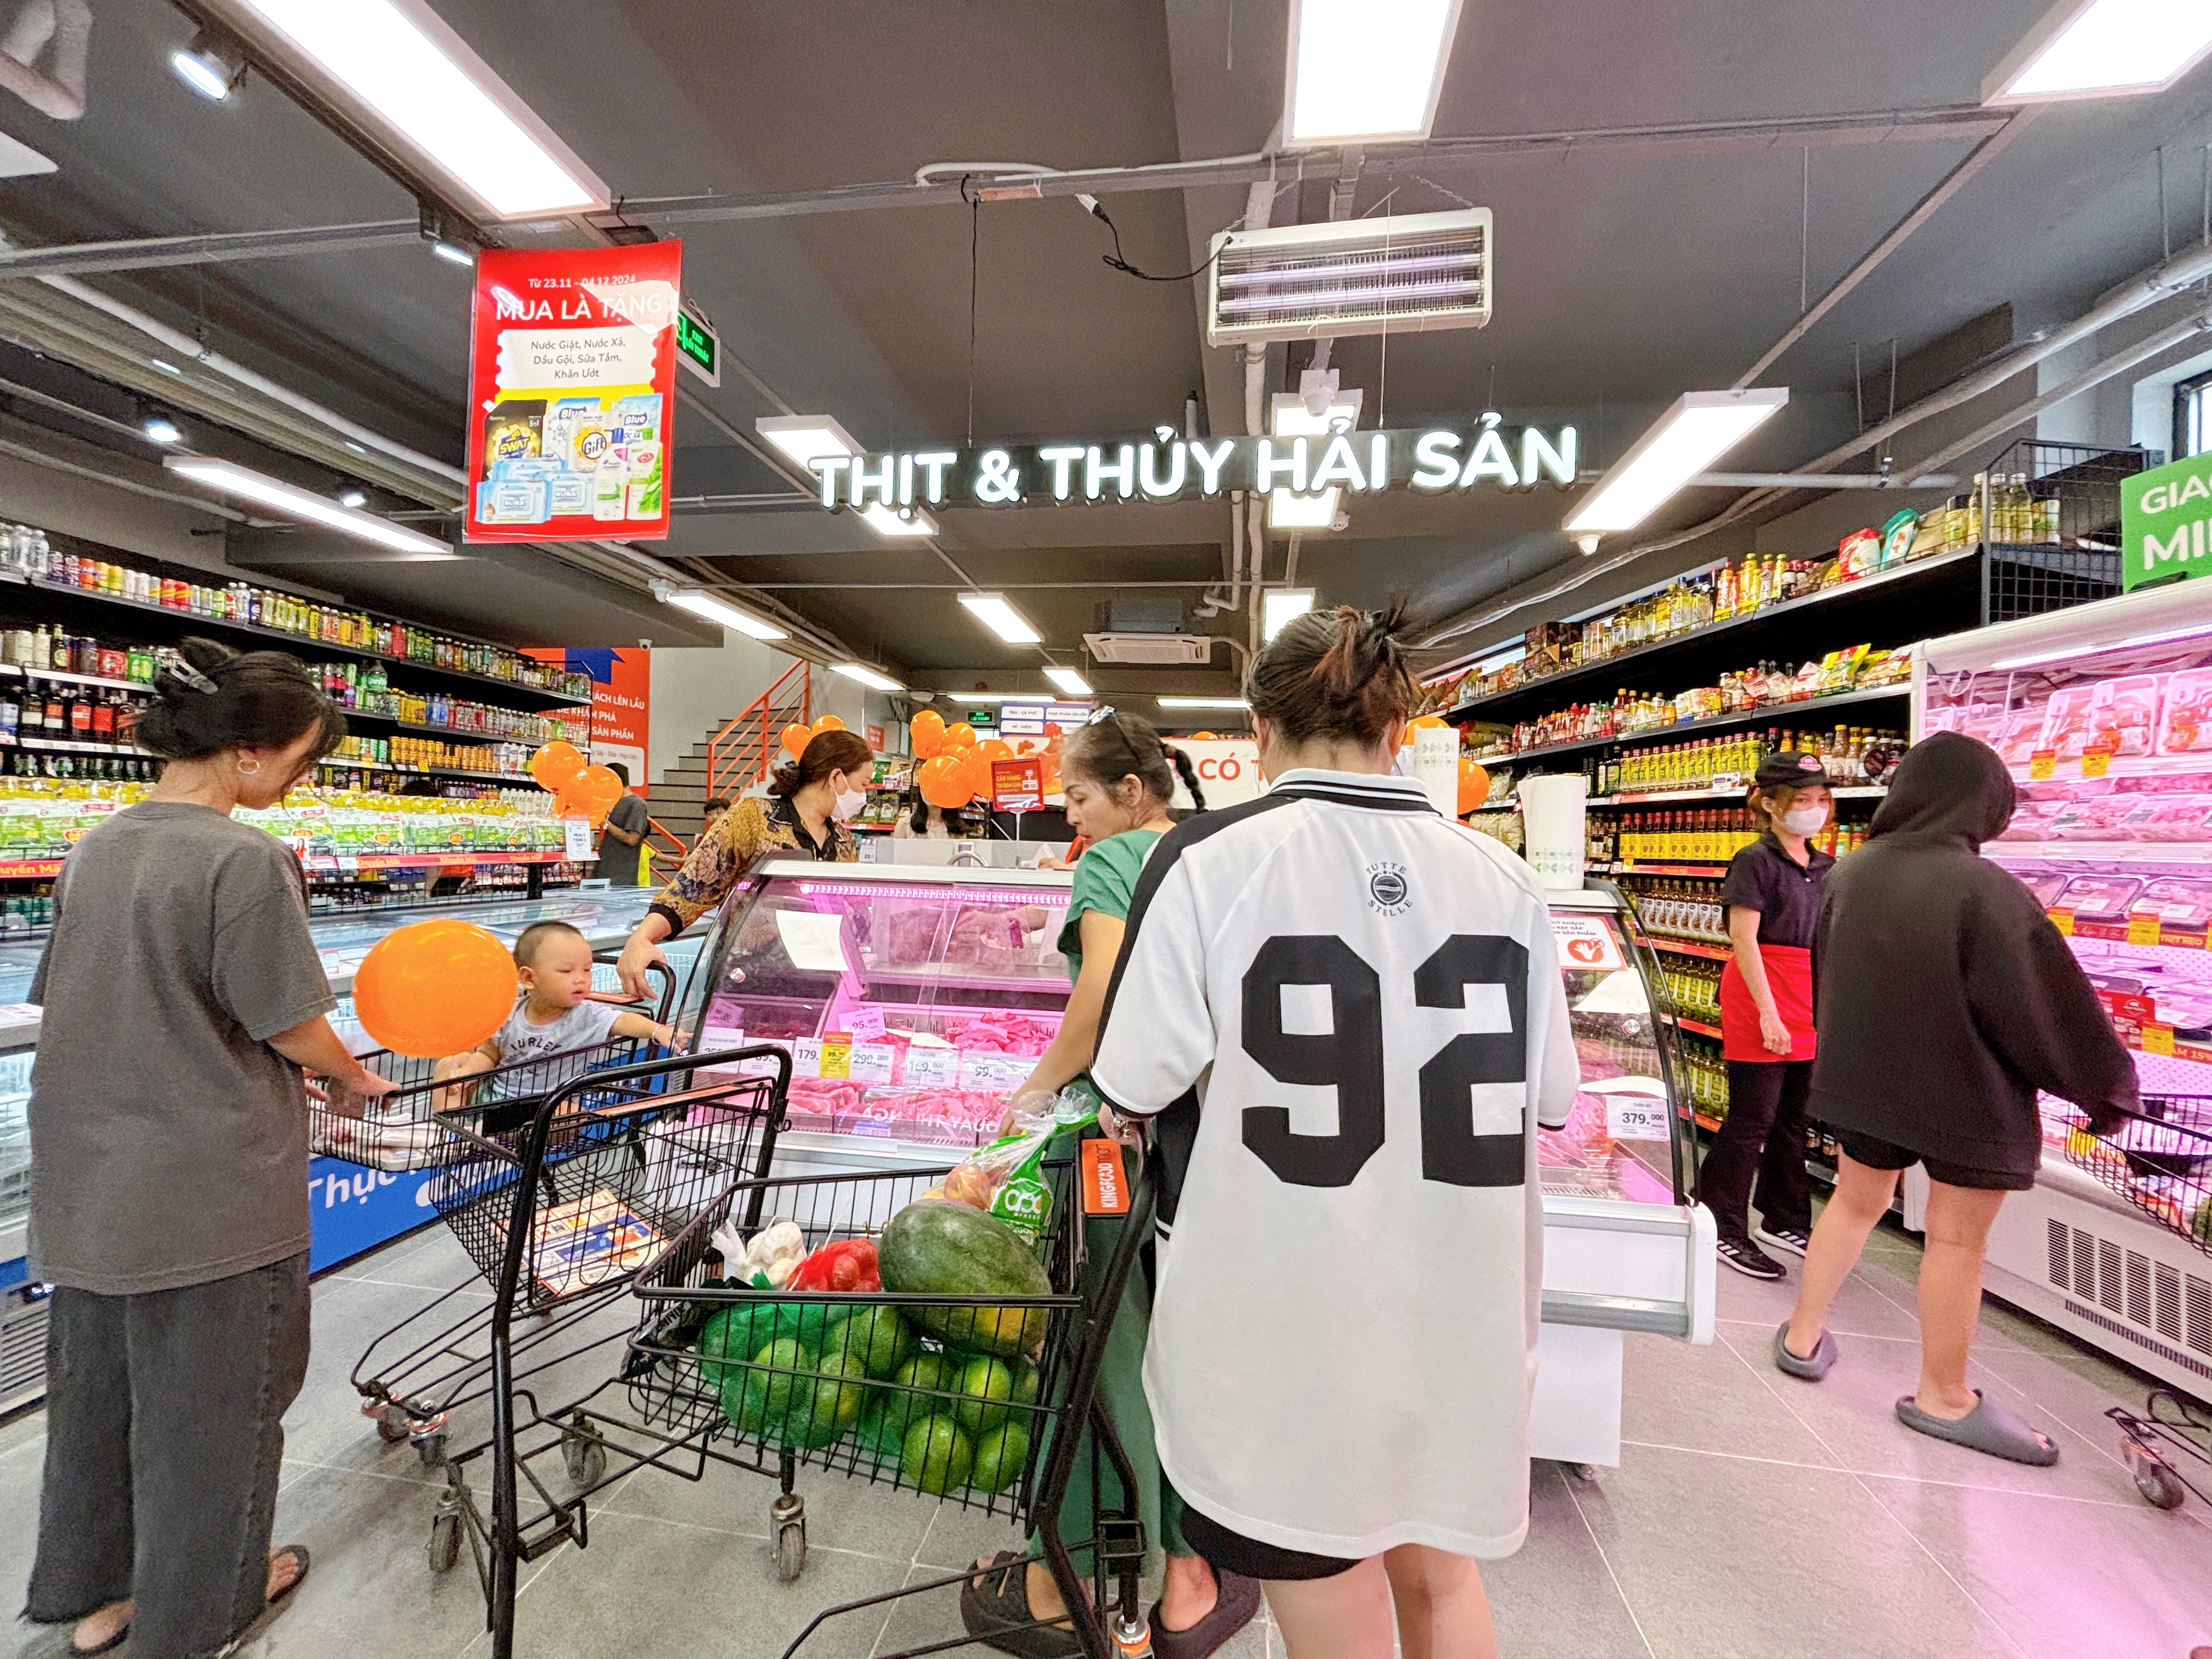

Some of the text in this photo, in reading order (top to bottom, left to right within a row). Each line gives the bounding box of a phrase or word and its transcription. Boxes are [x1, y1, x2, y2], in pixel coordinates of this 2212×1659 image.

[544, 278, 571, 287] 23.11
[582, 274, 635, 286] 04.12.2024
[496, 291, 662, 322] MUA LÀ TẶNG
[531, 339, 556, 349] Nước
[584, 338, 608, 348] Nước
[578, 354, 595, 363] Sữa
[555, 369, 578, 379] Khăn
[625, 415, 646, 425] Blue
[500, 438, 529, 455] SWAT
[583, 437, 605, 455] Gift
[808, 411, 1577, 520] THỊT & THỦY HẢI SẢN
[2141, 475, 2212, 515] GIA
[613, 694, 628, 707] LÊN
[599, 710, 617, 723] PHÁ
[1198, 752, 1240, 780] CÓ
[357, 858, 384, 866] Khuyến
[1366, 862, 1407, 874] TUTTE
[1368, 899, 1413, 916] STELLE
[1242, 934, 1529, 1188] 92
